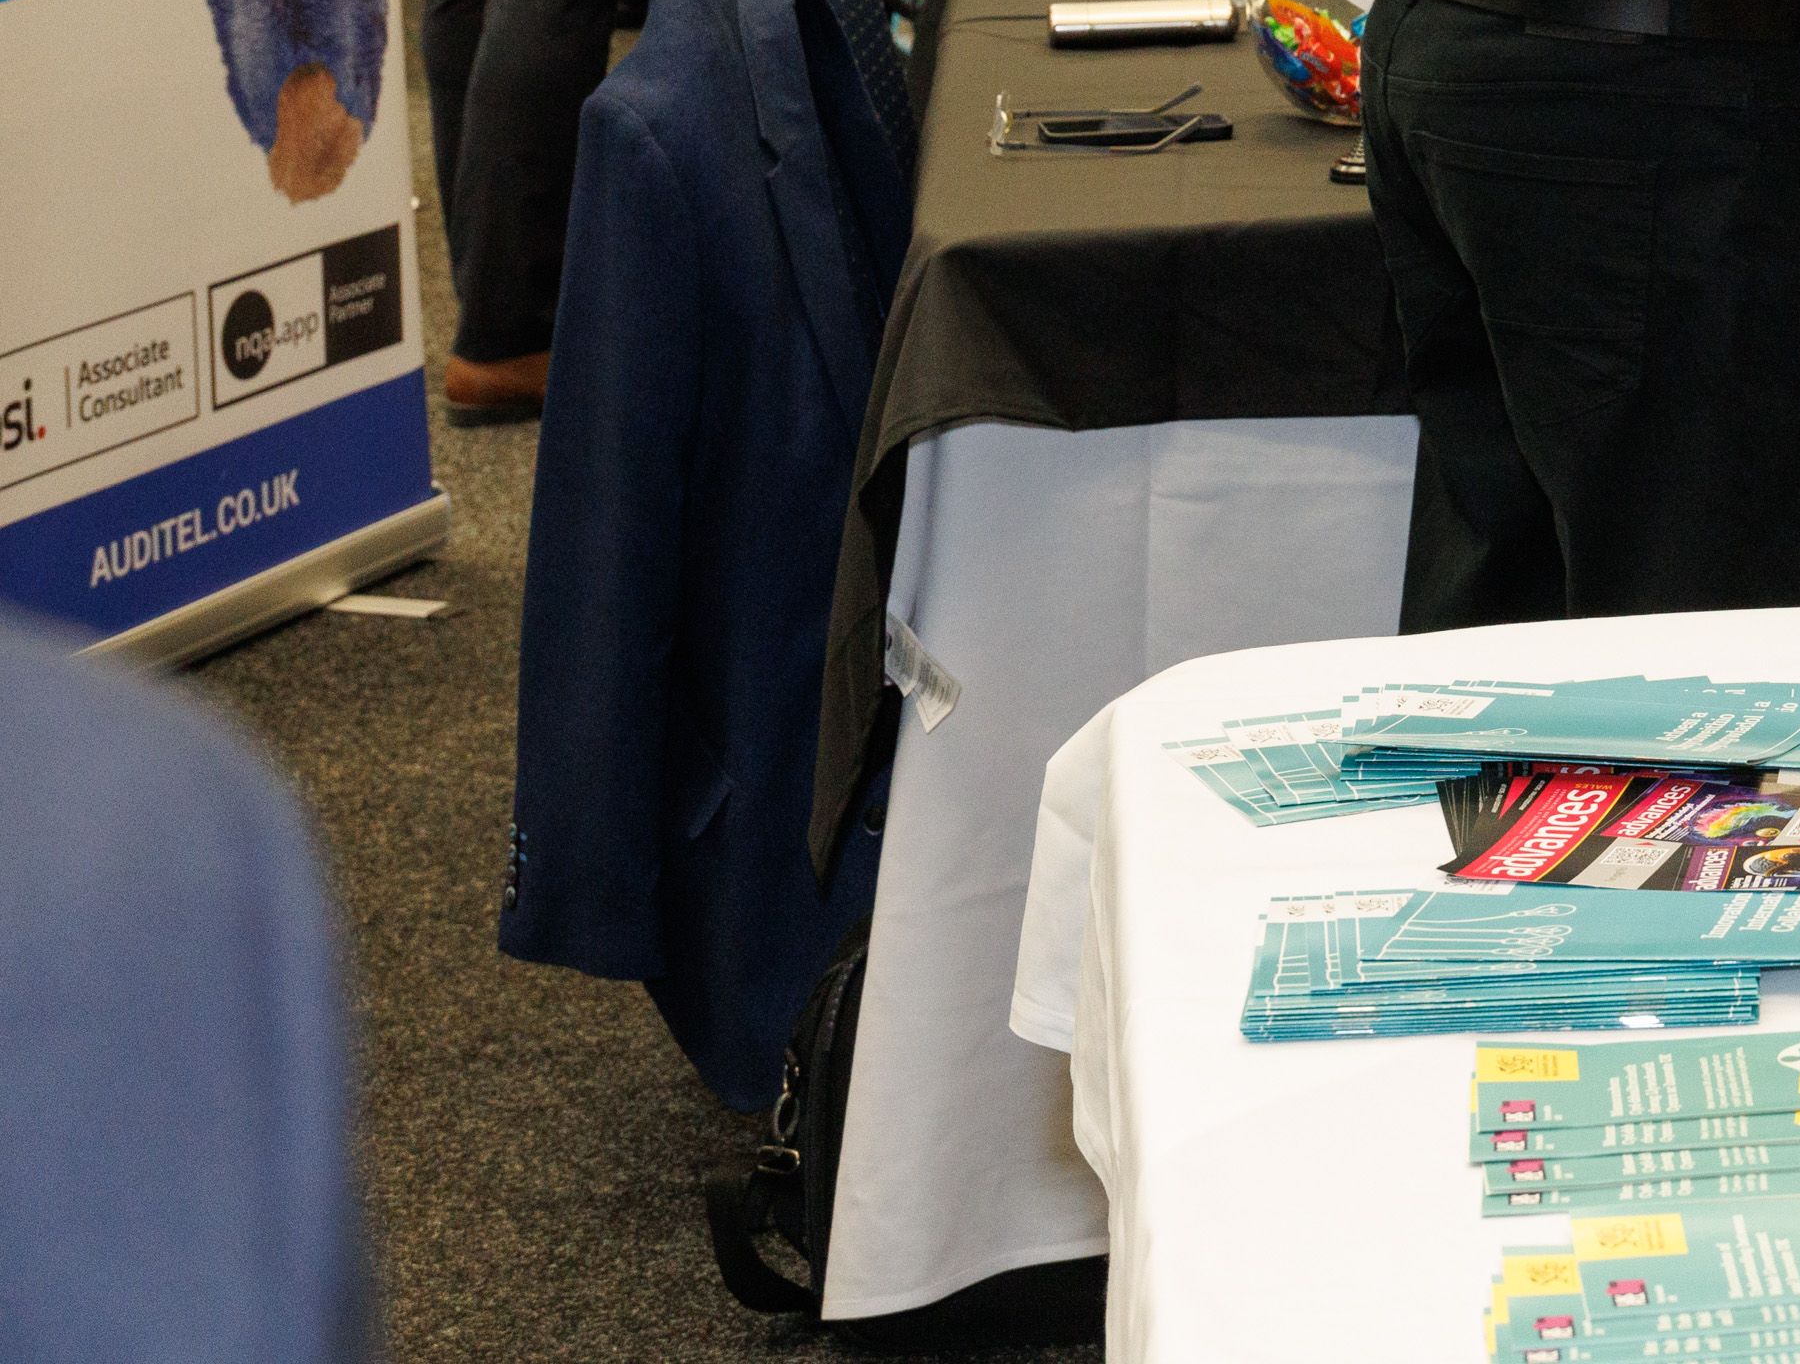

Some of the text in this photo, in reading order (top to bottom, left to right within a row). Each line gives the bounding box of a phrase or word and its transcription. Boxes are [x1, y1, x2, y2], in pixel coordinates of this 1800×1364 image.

[77, 337, 171, 388] Associate
[79, 365, 184, 423] Consultant
[89, 470, 301, 587] AUDITEL.CO.UK
[1490, 789, 1607, 877] advances
[1617, 785, 1691, 836] advances
[1689, 850, 1729, 890] advances
[1700, 892, 1752, 938] Innovation
